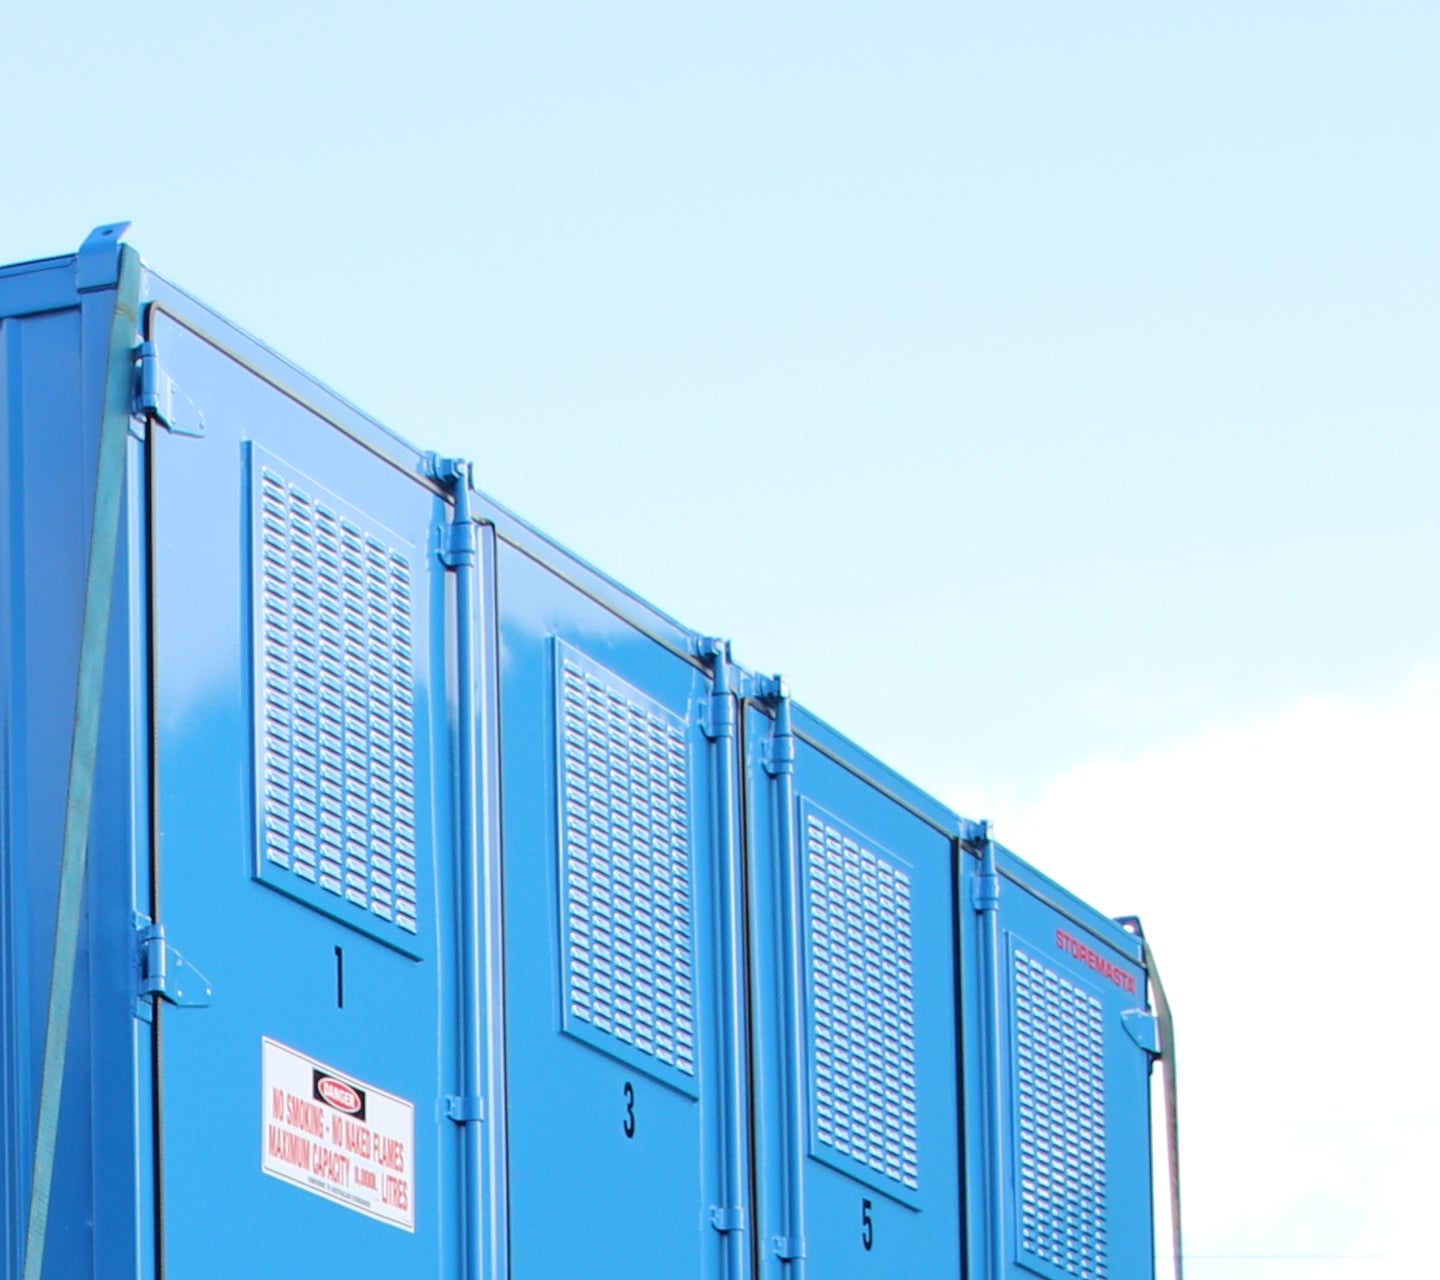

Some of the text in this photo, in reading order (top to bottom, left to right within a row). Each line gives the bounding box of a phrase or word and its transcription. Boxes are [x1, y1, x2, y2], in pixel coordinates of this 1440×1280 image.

[334, 945, 343, 1008] 1
[1056, 928, 1136, 995] STOREMASTA
[272, 1087, 285, 1121] NO
[287, 1094, 324, 1138] SMOKING
[331, 1114, 343, 1147] NO
[345, 1118, 371, 1159] NAKED
[373, 1132, 405, 1172] FLAMES
[623, 1081, 636, 1139] 3
[268, 1124, 310, 1170] MAXIMUM
[312, 1143, 350, 1187] CAPACITY
[382, 1172, 408, 1212] LITRES
[862, 1198, 873, 1252] 5
